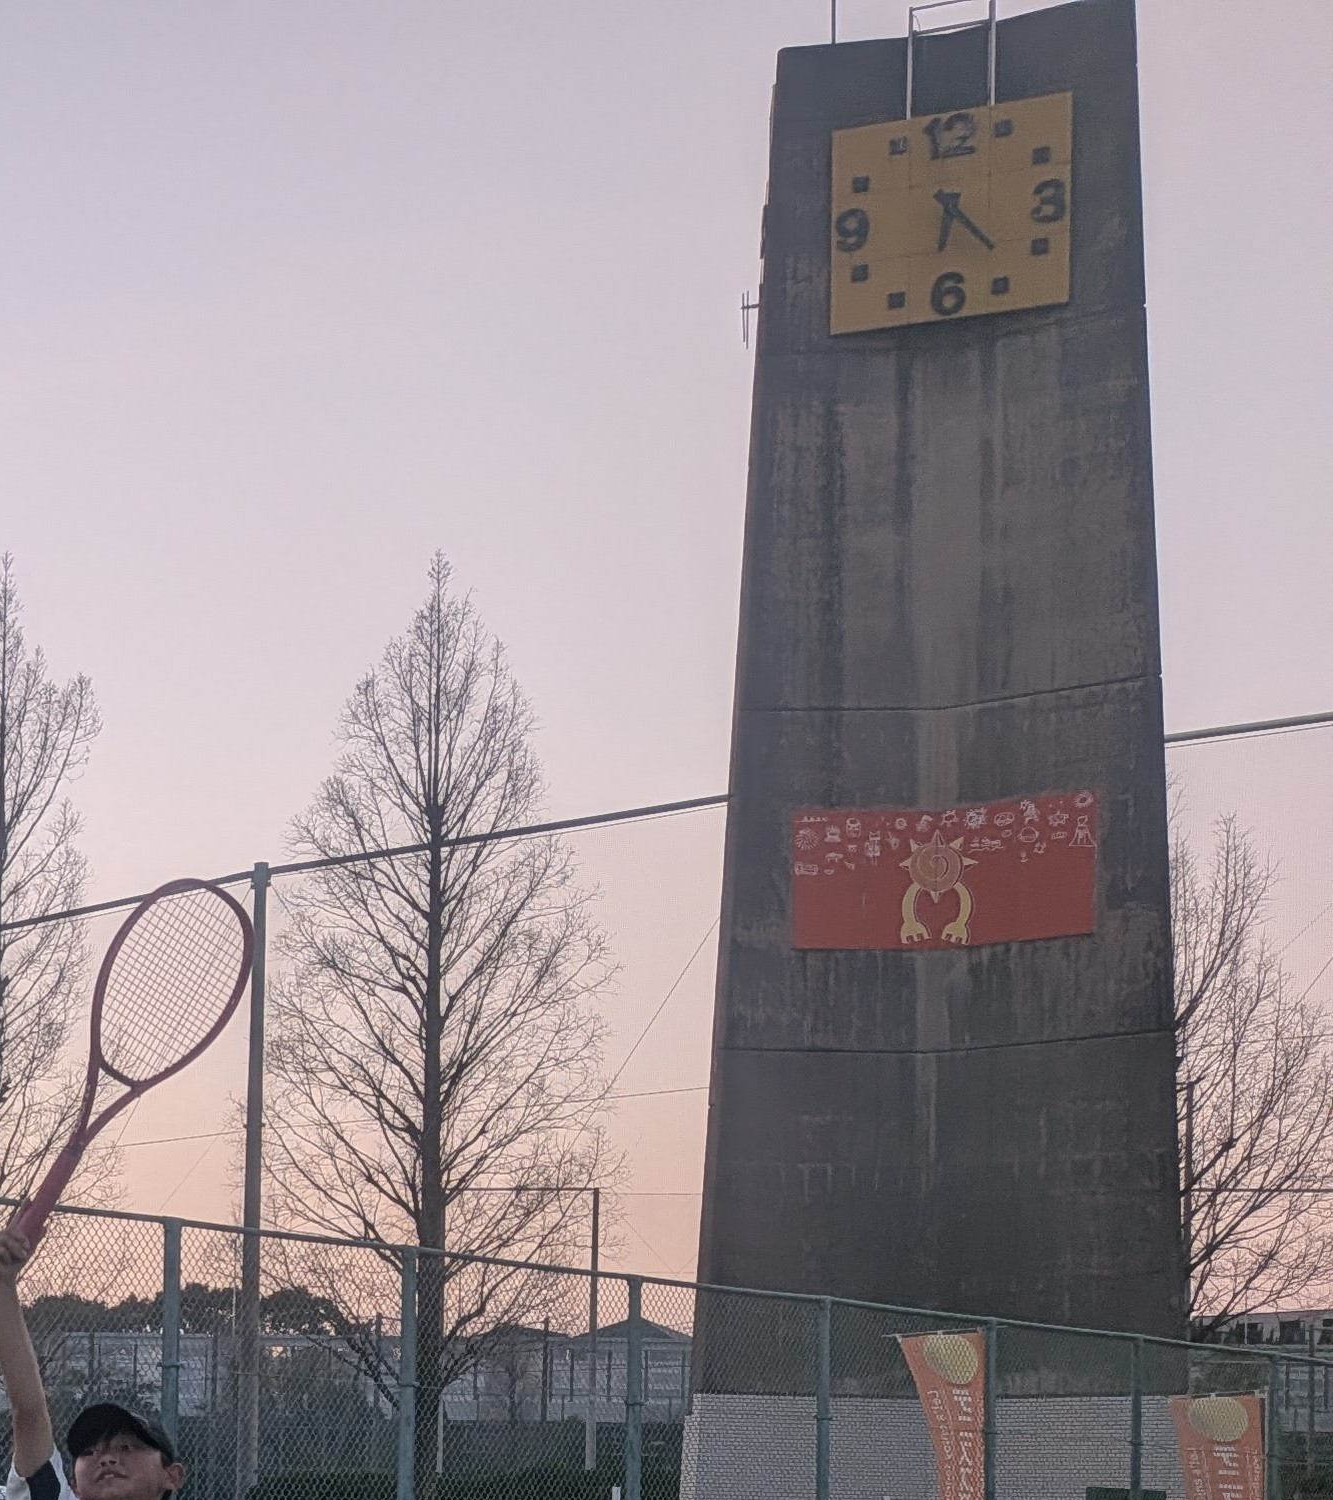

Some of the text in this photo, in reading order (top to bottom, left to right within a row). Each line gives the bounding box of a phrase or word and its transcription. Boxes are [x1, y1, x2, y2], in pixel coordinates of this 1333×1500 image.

[923, 112, 977, 161] 12
[1031, 178, 1066, 224] 3
[835, 208, 870, 252] 9
[931, 272, 966, 316] 6
